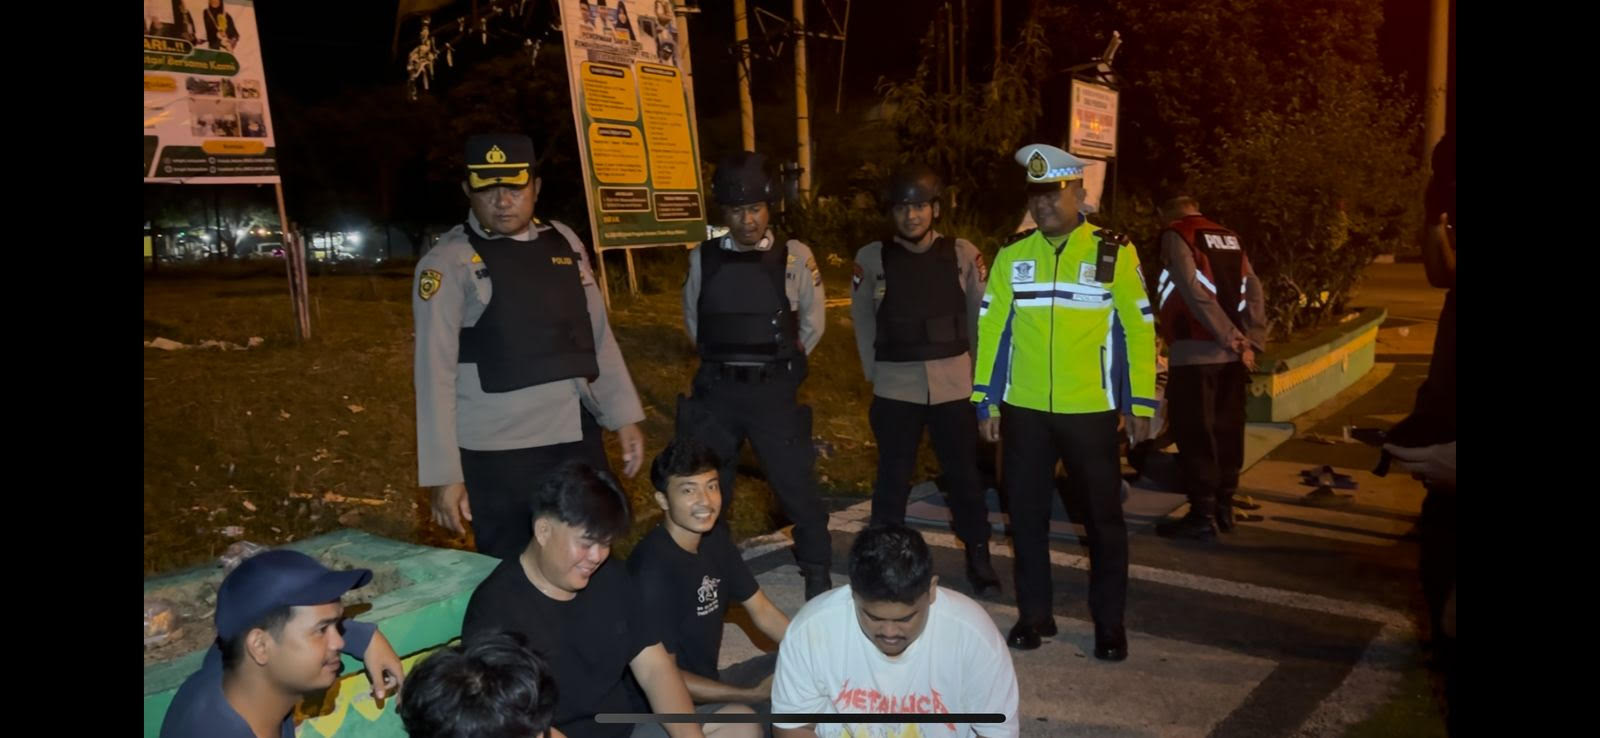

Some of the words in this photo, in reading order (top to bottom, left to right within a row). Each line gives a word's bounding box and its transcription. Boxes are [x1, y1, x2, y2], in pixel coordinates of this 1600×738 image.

[209, 60, 236, 71] Kami
[1204, 233, 1241, 250] POLISI
[551, 256, 573, 266] POLISI
[834, 679, 955, 731] METALLICA
